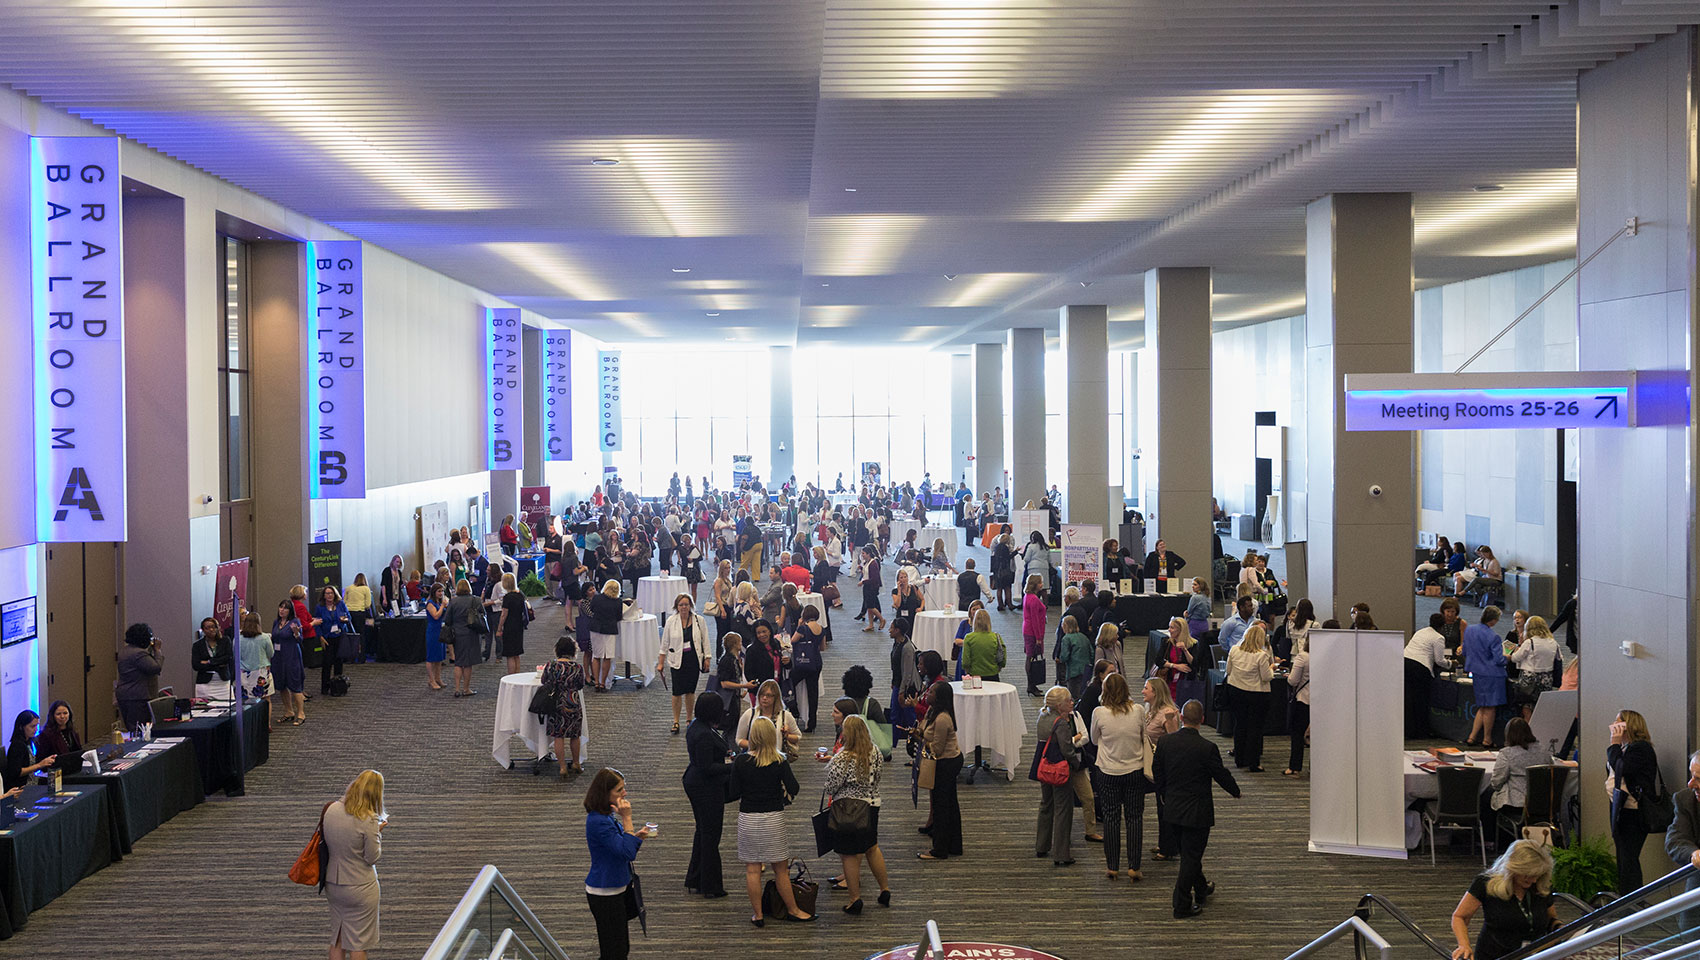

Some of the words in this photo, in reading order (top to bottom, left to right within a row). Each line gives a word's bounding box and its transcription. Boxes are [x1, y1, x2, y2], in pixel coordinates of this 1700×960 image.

[80, 165, 107, 338] GRAND
[46, 165, 75, 449] BALLROOM
[337, 258, 355, 369] GRAND
[316, 258, 335, 440] BALLROOM
[492, 318, 504, 434] BALLROOM
[505, 318, 517, 389] GRAND
[557, 337, 567, 395] GRAND
[545, 337, 556, 432] BALLROOM
[603, 356, 612, 429] BALLROOM
[611, 356, 620, 402] GRAND
[604, 432, 616, 447] C
[1381, 402, 1450, 421] Meeting
[1455, 402, 1515, 417] Rooms
[1520, 401, 1580, 416] 25-26
[319, 450, 348, 486] B
[493, 439, 513, 462] B
[547, 436, 562, 455] C
[53, 467, 105, 521] A
[311, 554, 339, 562] CenturyLink
